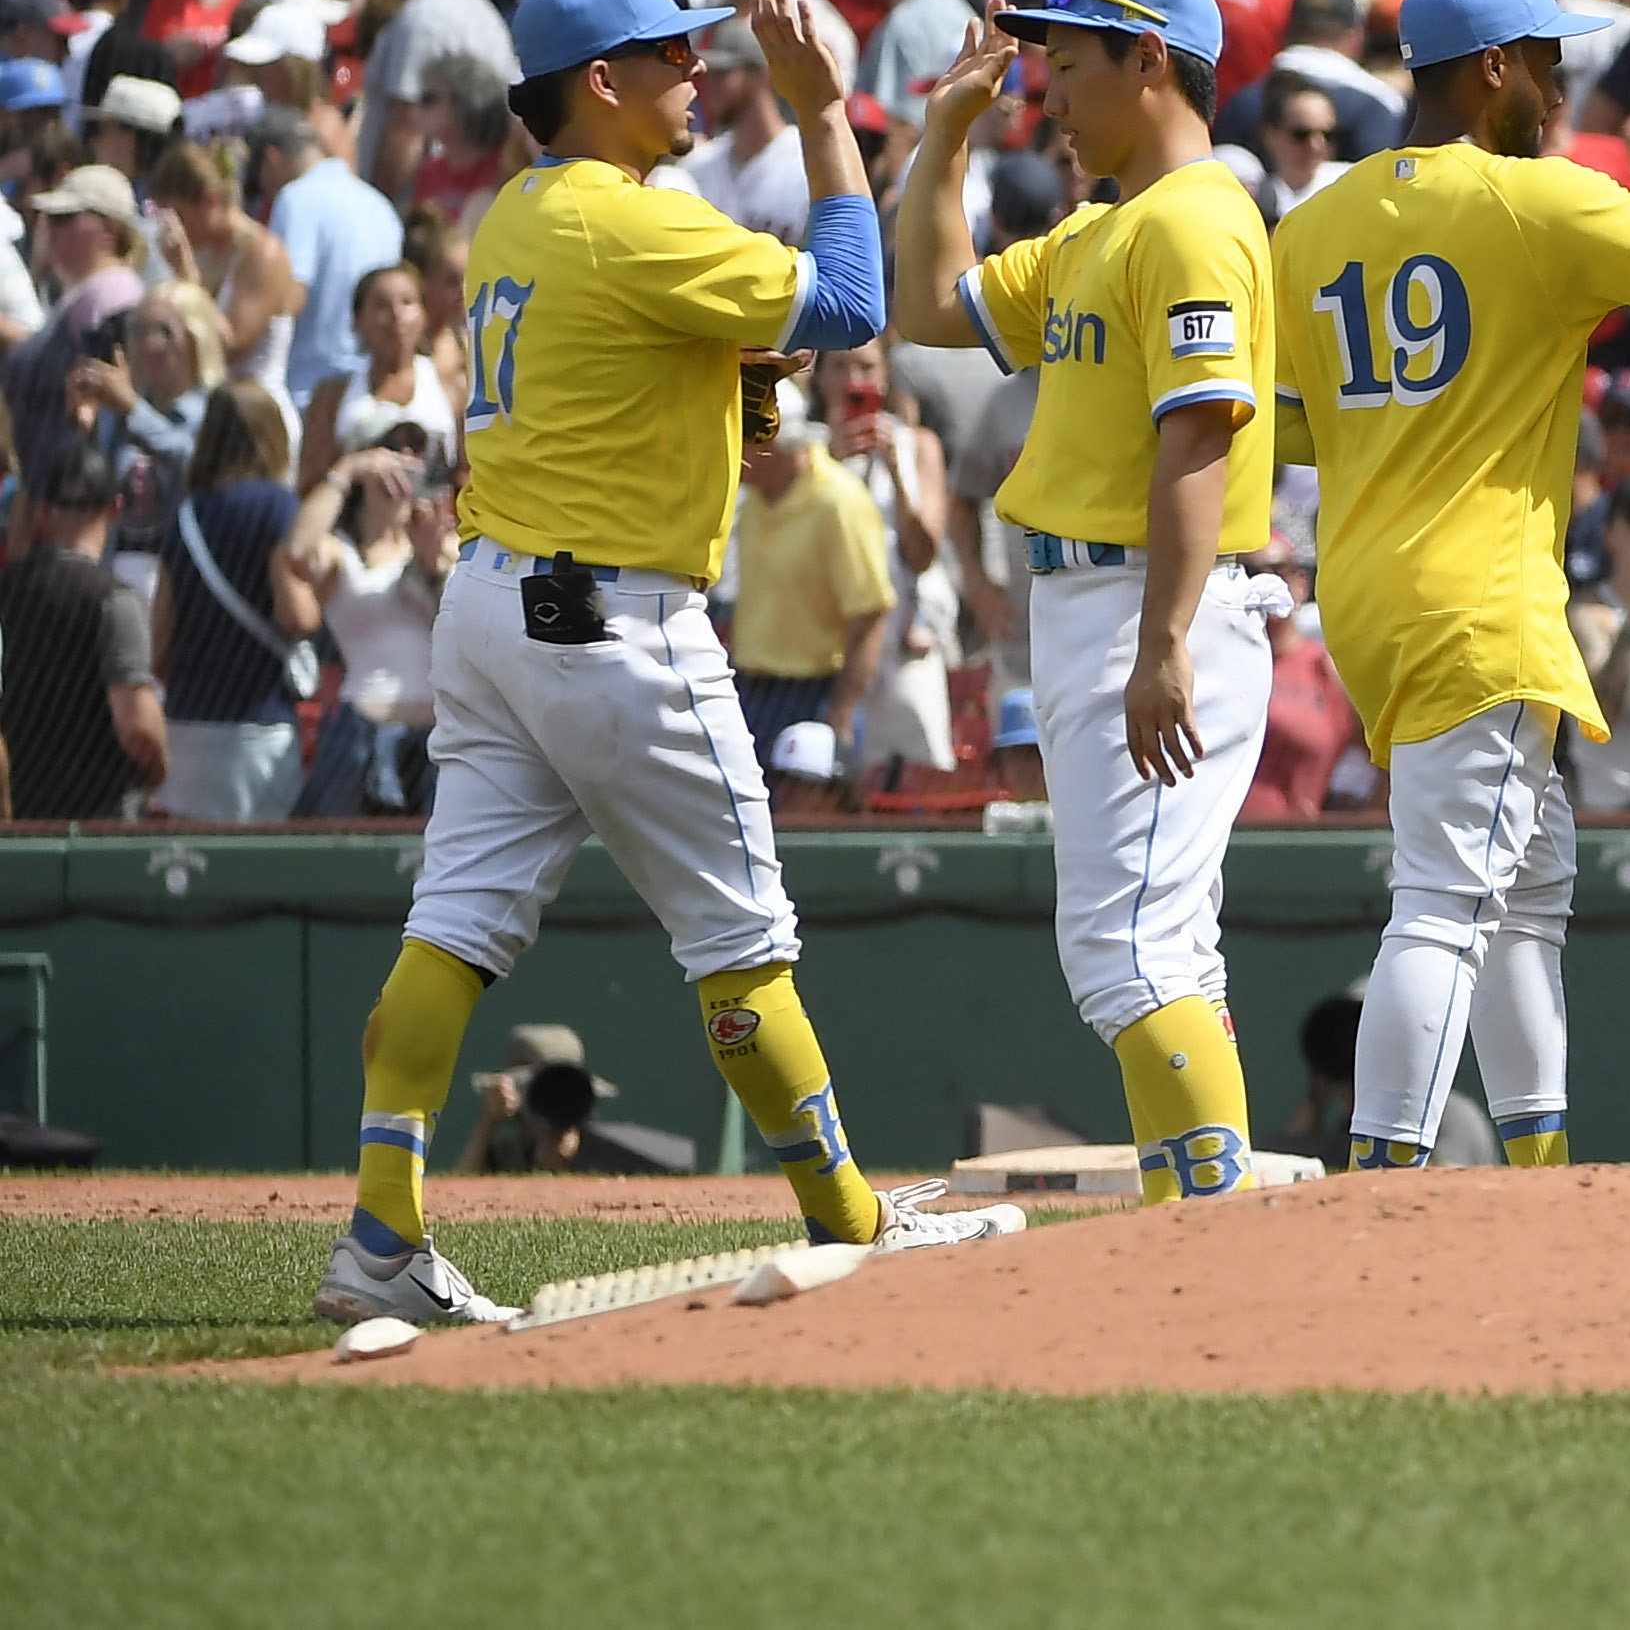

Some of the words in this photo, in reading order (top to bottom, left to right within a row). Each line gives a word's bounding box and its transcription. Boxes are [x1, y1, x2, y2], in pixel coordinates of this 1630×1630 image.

[466, 276, 536, 432] 17
[1183, 315, 1215, 341] 617
[1311, 253, 1473, 410] 19
[1159, 1121, 1247, 1200] B
